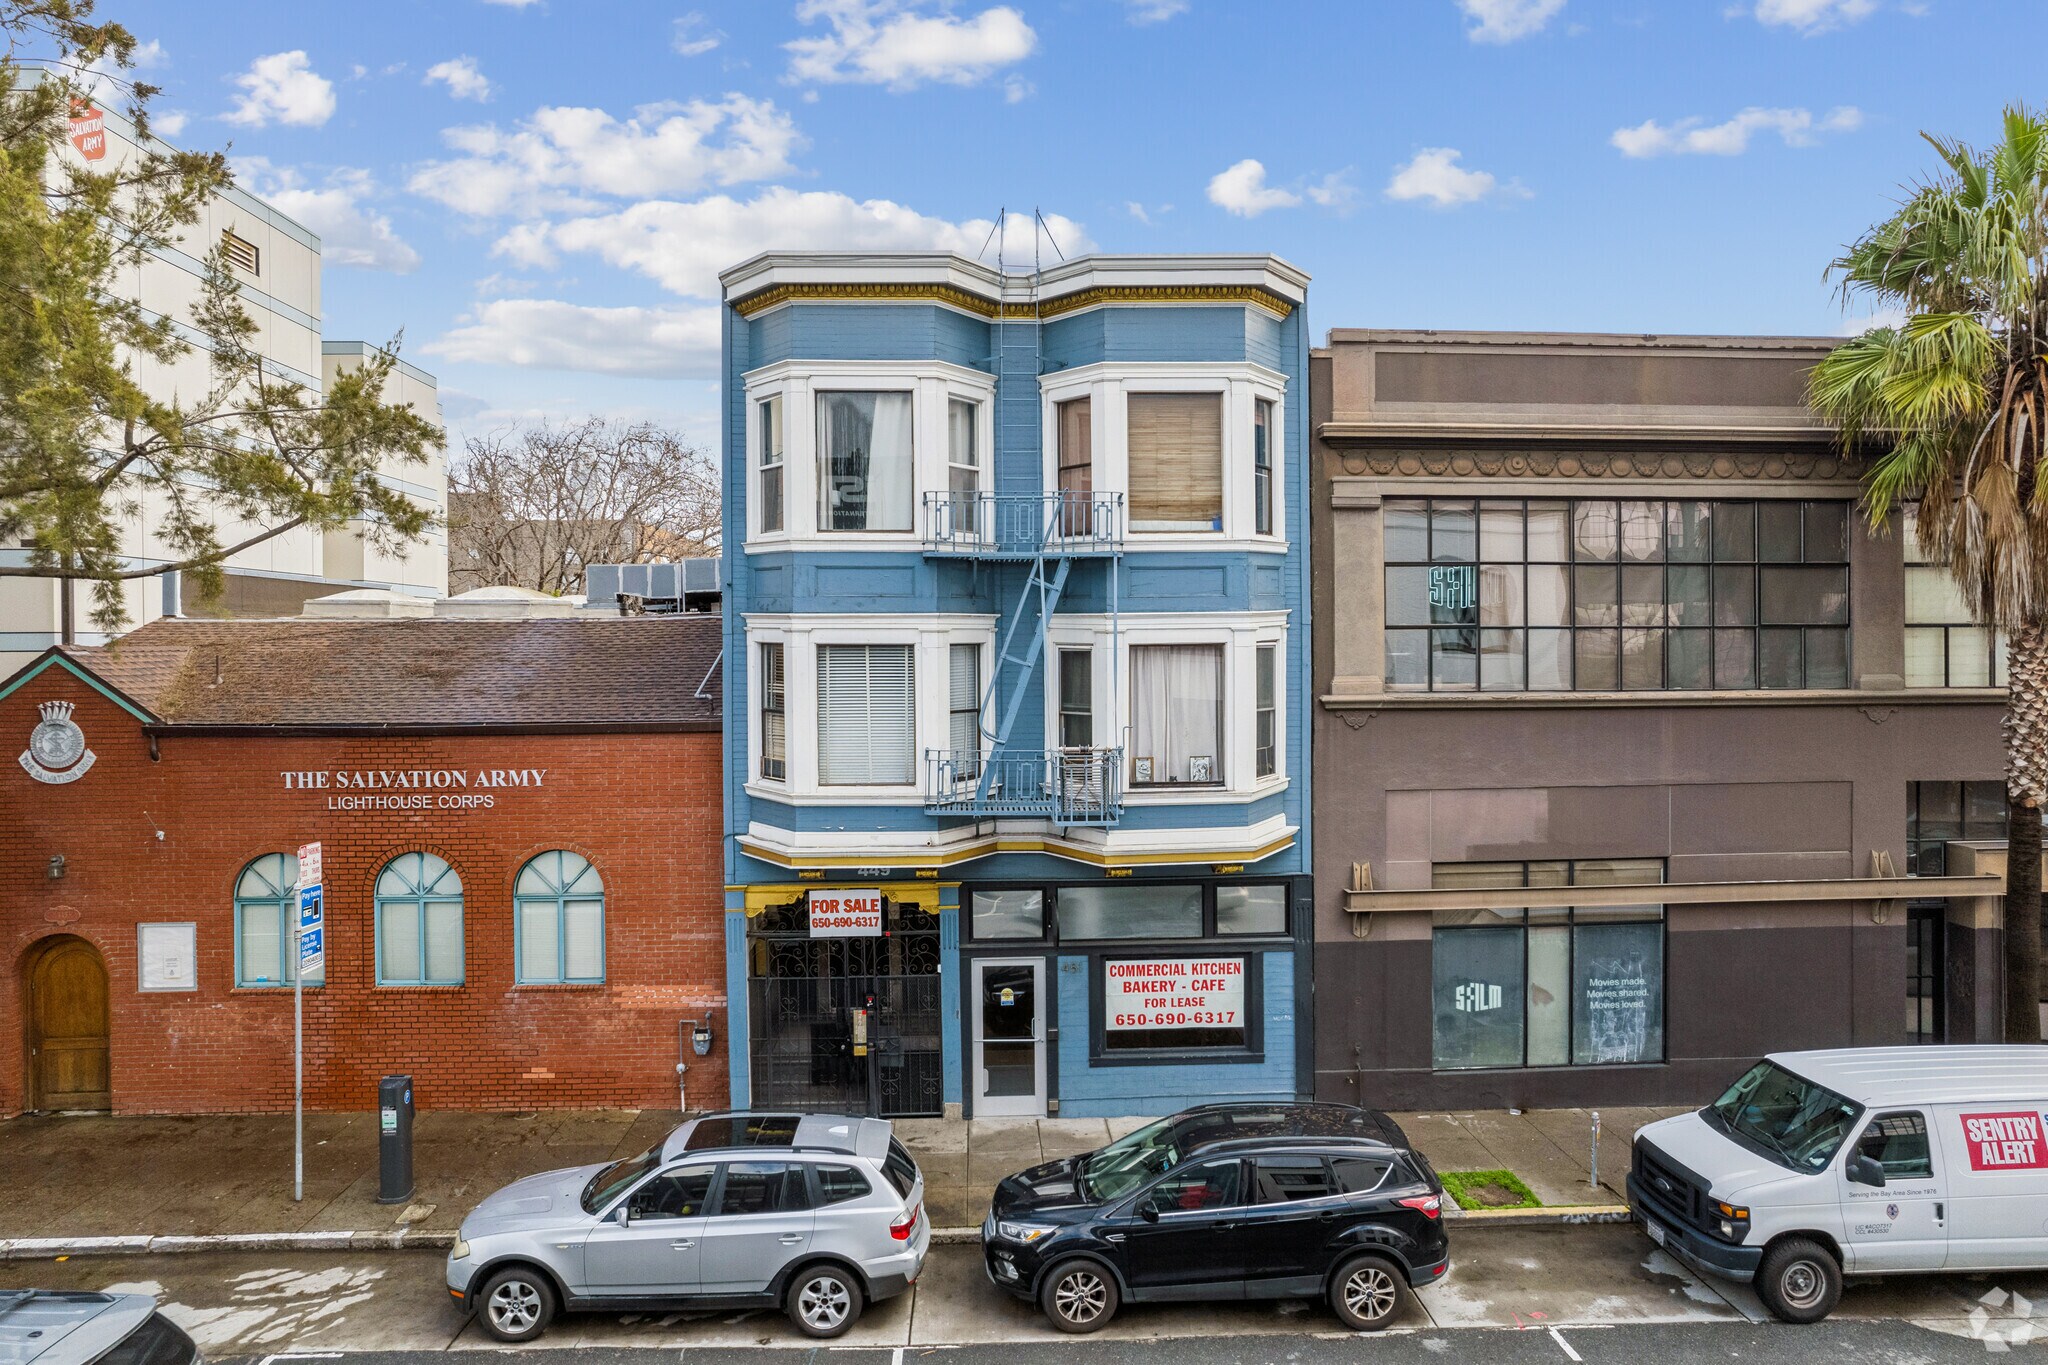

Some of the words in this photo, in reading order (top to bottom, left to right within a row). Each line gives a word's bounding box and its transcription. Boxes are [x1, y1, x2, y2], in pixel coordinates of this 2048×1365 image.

[69, 117, 103, 137] SALVATION
[82, 134, 102, 152] ARMY
[21, 755, 36, 772] THE
[35, 769, 78, 783] SALVATION
[77, 753, 94, 774] ARMY
[281, 771, 329, 789] THE
[335, 770, 468, 789] SALVATION
[474, 769, 548, 788] ARMY
[328, 796, 432, 810] LIGHTHOUSE
[438, 795, 494, 808] CORPS
[858, 868, 890, 876] 449
[302, 892, 310, 900] Pay
[310, 889, 321, 897] here
[811, 899, 840, 914] FOR
[843, 898, 879, 913] SALE
[812, 917, 879, 928] 650-690-6317
[302, 941, 317, 950] License
[1109, 963, 1187, 977] COMMERCIAL
[1191, 962, 1241, 975] KITCHEN
[1123, 980, 1177, 993] BAKERY
[1191, 979, 1226, 991] CAFE
[1589, 978, 1620, 987] Movies
[1621, 978, 1647, 986] made.
[1587, 989, 1618, 998] Movies
[1618, 988, 1649, 997] shared.
[1144, 998, 1167, 1008] FOR
[1170, 997, 1205, 1008] LEASE
[1590, 1001, 1620, 1010] Movies
[1621, 1000, 1646, 1008] loved.
[1115, 1011, 1235, 1026] 650-690-6317
[1966, 1116, 2039, 1142] SENTRY
[1981, 1140, 2036, 1165] ALERT
